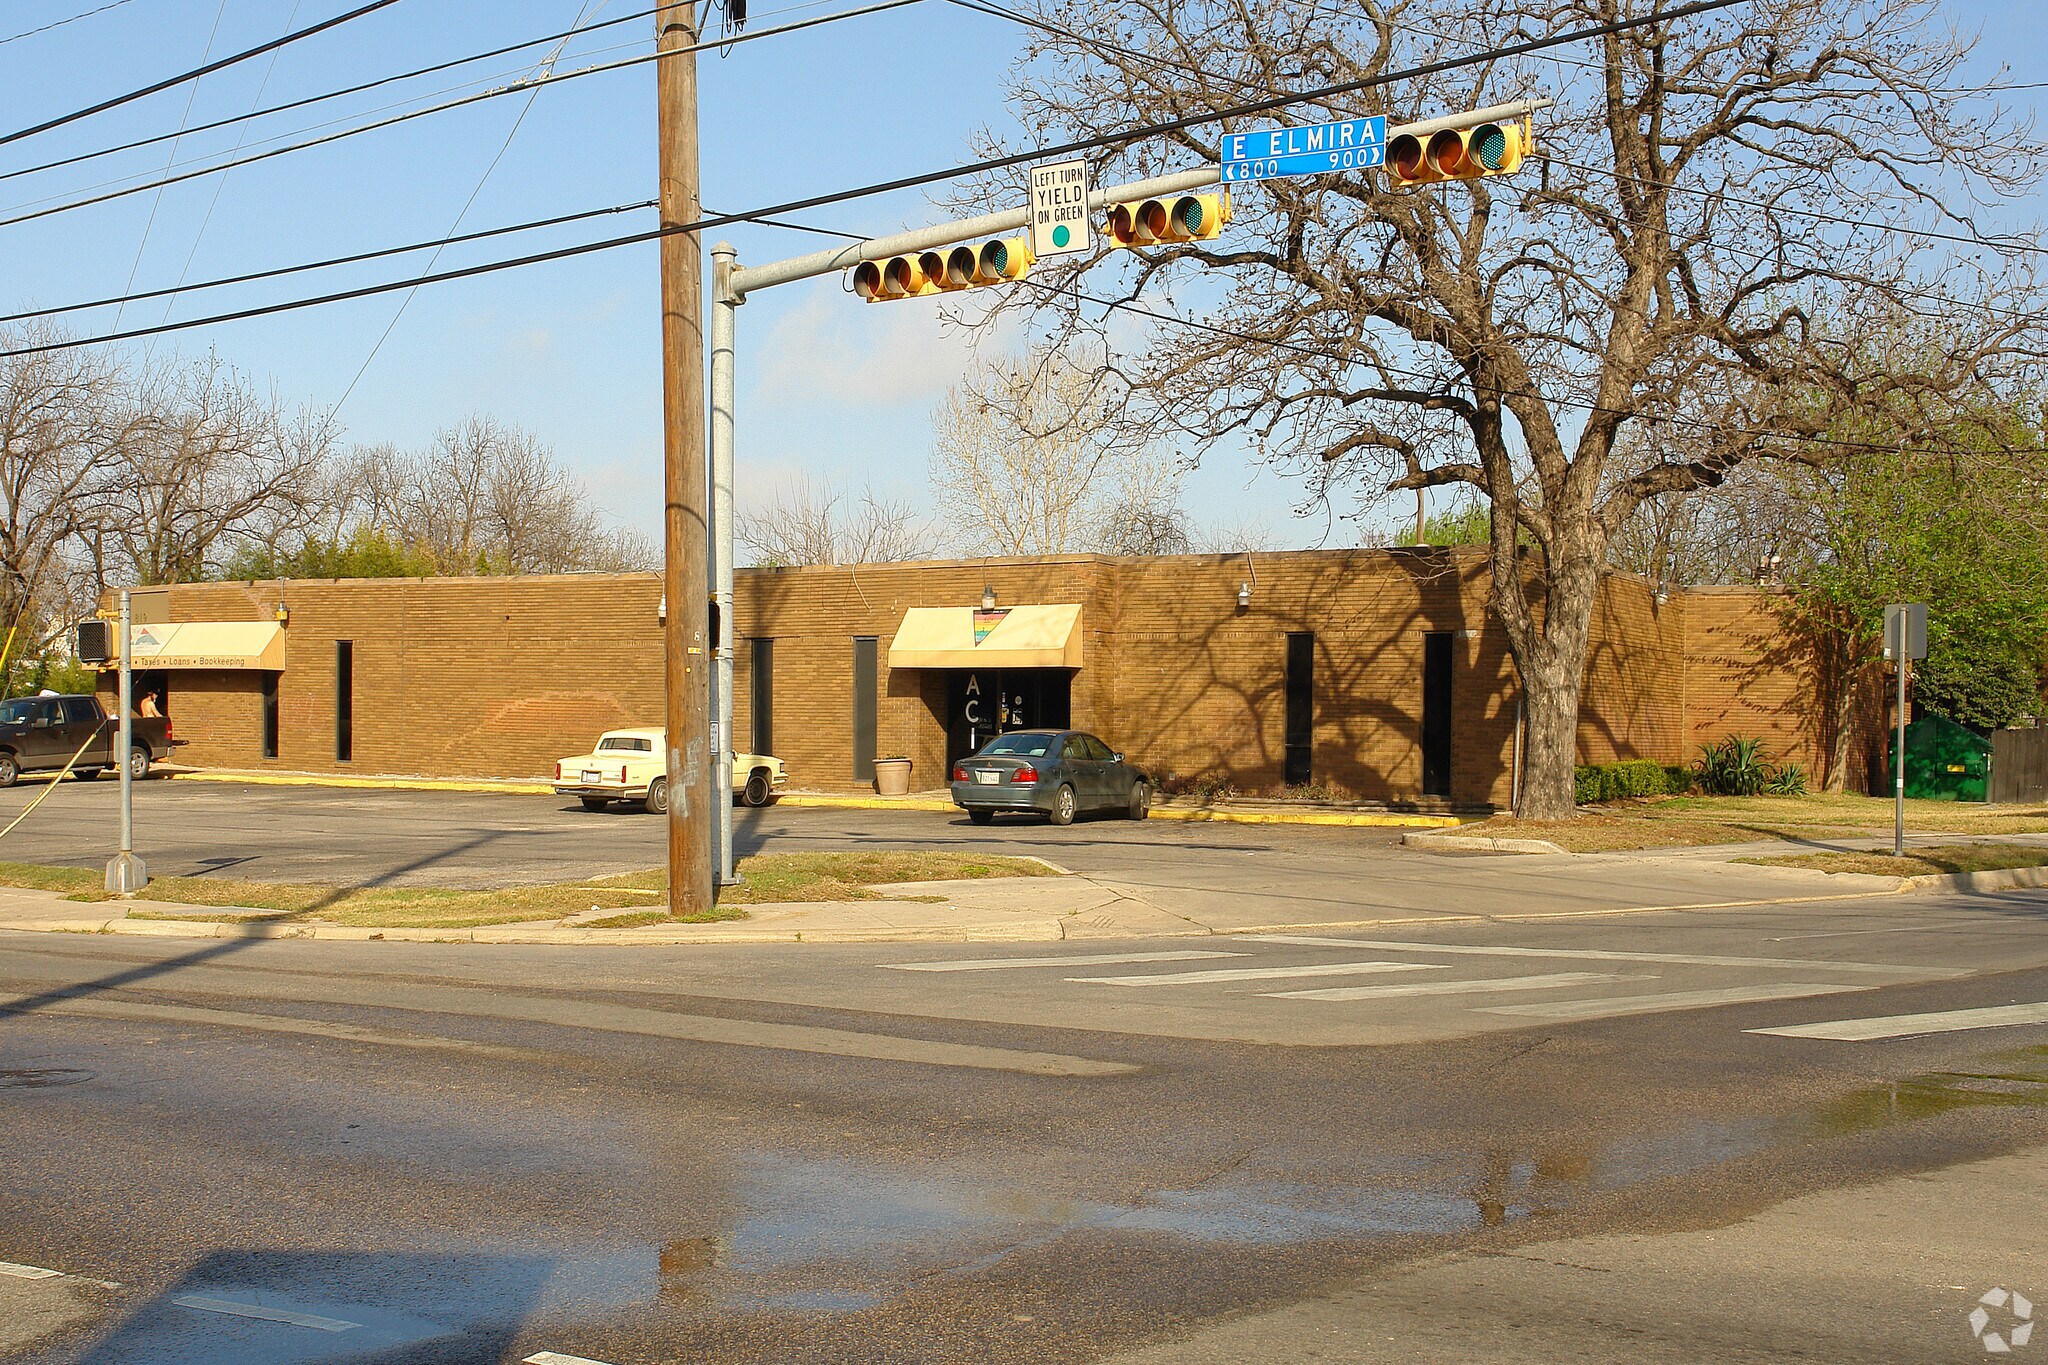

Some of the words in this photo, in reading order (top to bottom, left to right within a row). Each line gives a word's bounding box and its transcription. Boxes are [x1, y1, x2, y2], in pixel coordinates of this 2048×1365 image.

[1233, 136, 1246, 160] E
[1270, 120, 1376, 156] ELMIRA
[1239, 160, 1278, 179] 800
[1329, 149, 1367, 169] 900
[1034, 171, 1056, 188] LEFT
[1060, 168, 1083, 184] TURN
[1038, 185, 1082, 207] YIELD
[1038, 210, 1050, 224] ON
[1054, 205, 1083, 222] GREEN
[141, 657, 161, 666] Taxes
[169, 657, 190, 666] Loans
[199, 657, 245, 668] Bookkeeping
